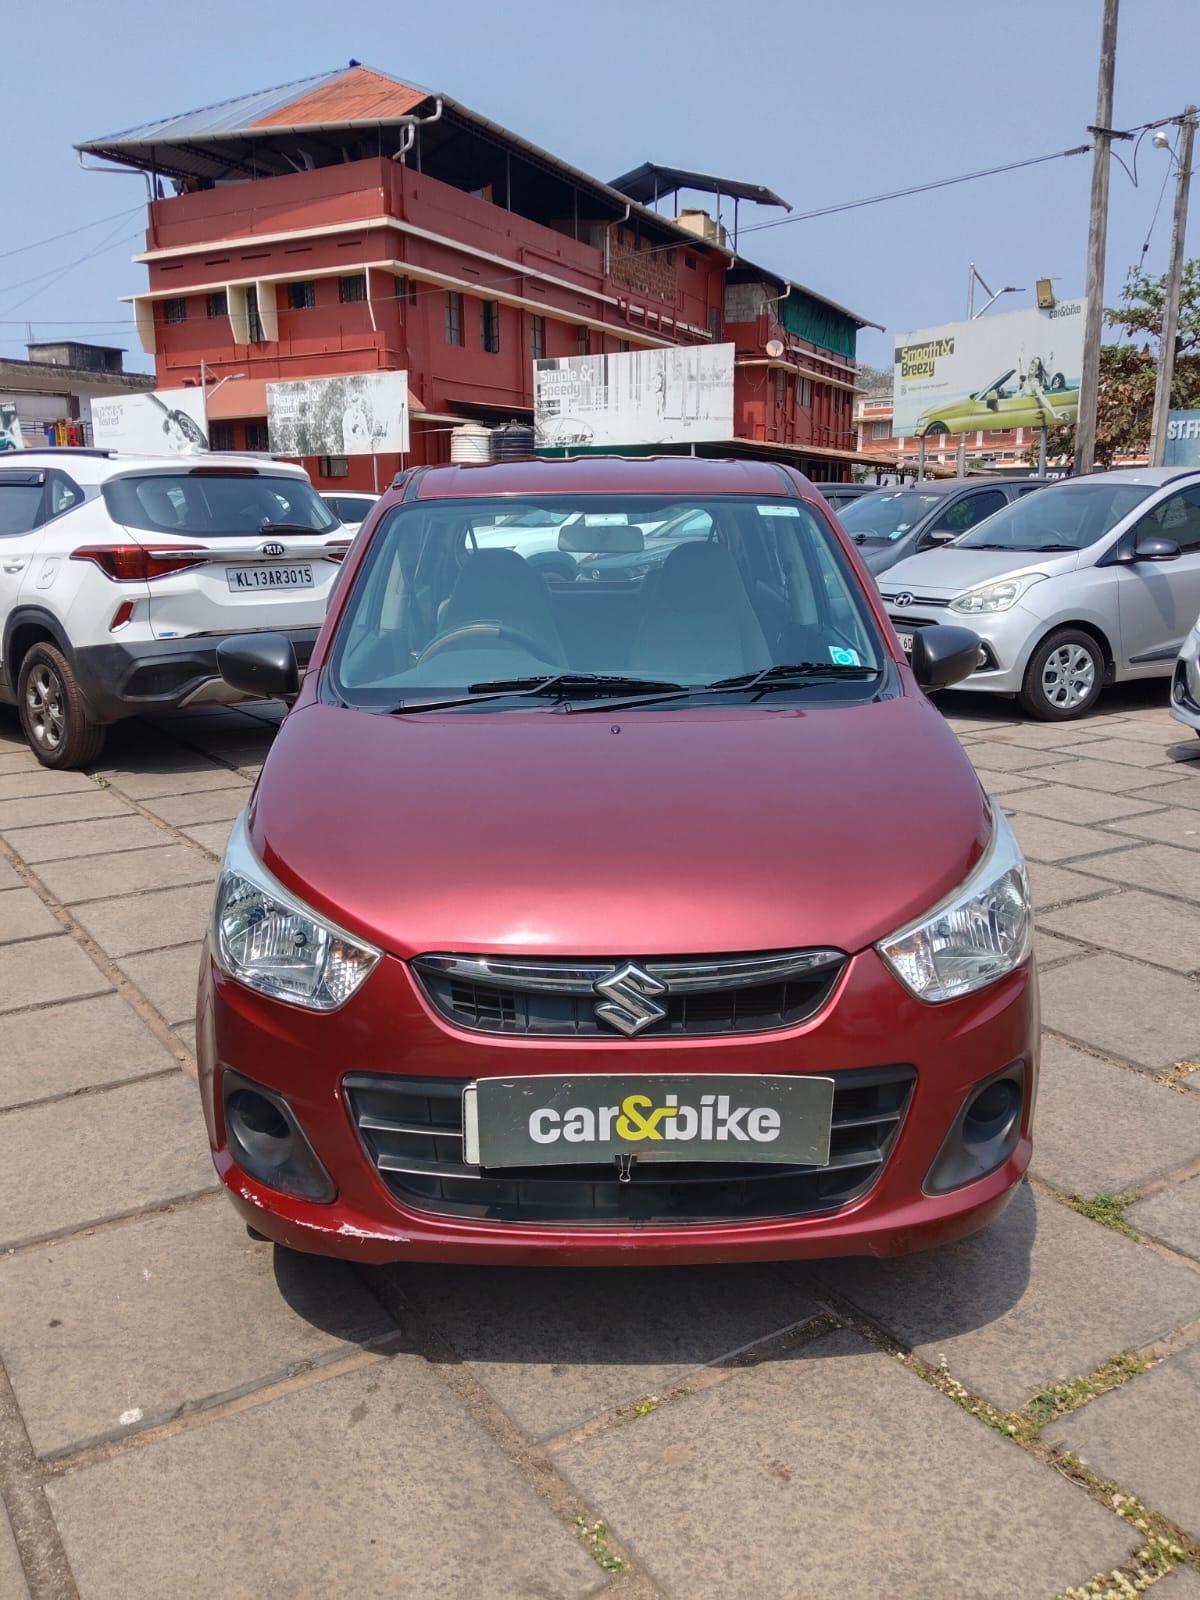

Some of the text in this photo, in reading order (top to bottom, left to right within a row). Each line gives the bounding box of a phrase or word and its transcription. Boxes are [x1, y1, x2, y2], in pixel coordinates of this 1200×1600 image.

[901, 342, 941, 362] Smooth
[540, 364, 595, 384] Simple &
[901, 360, 935, 377] Breezy
[540, 382, 581, 399] Speedy
[266, 545, 283, 555] KIA
[236, 569, 312, 587] KL13AR3015
[528, 1094, 781, 1144] car&bike
